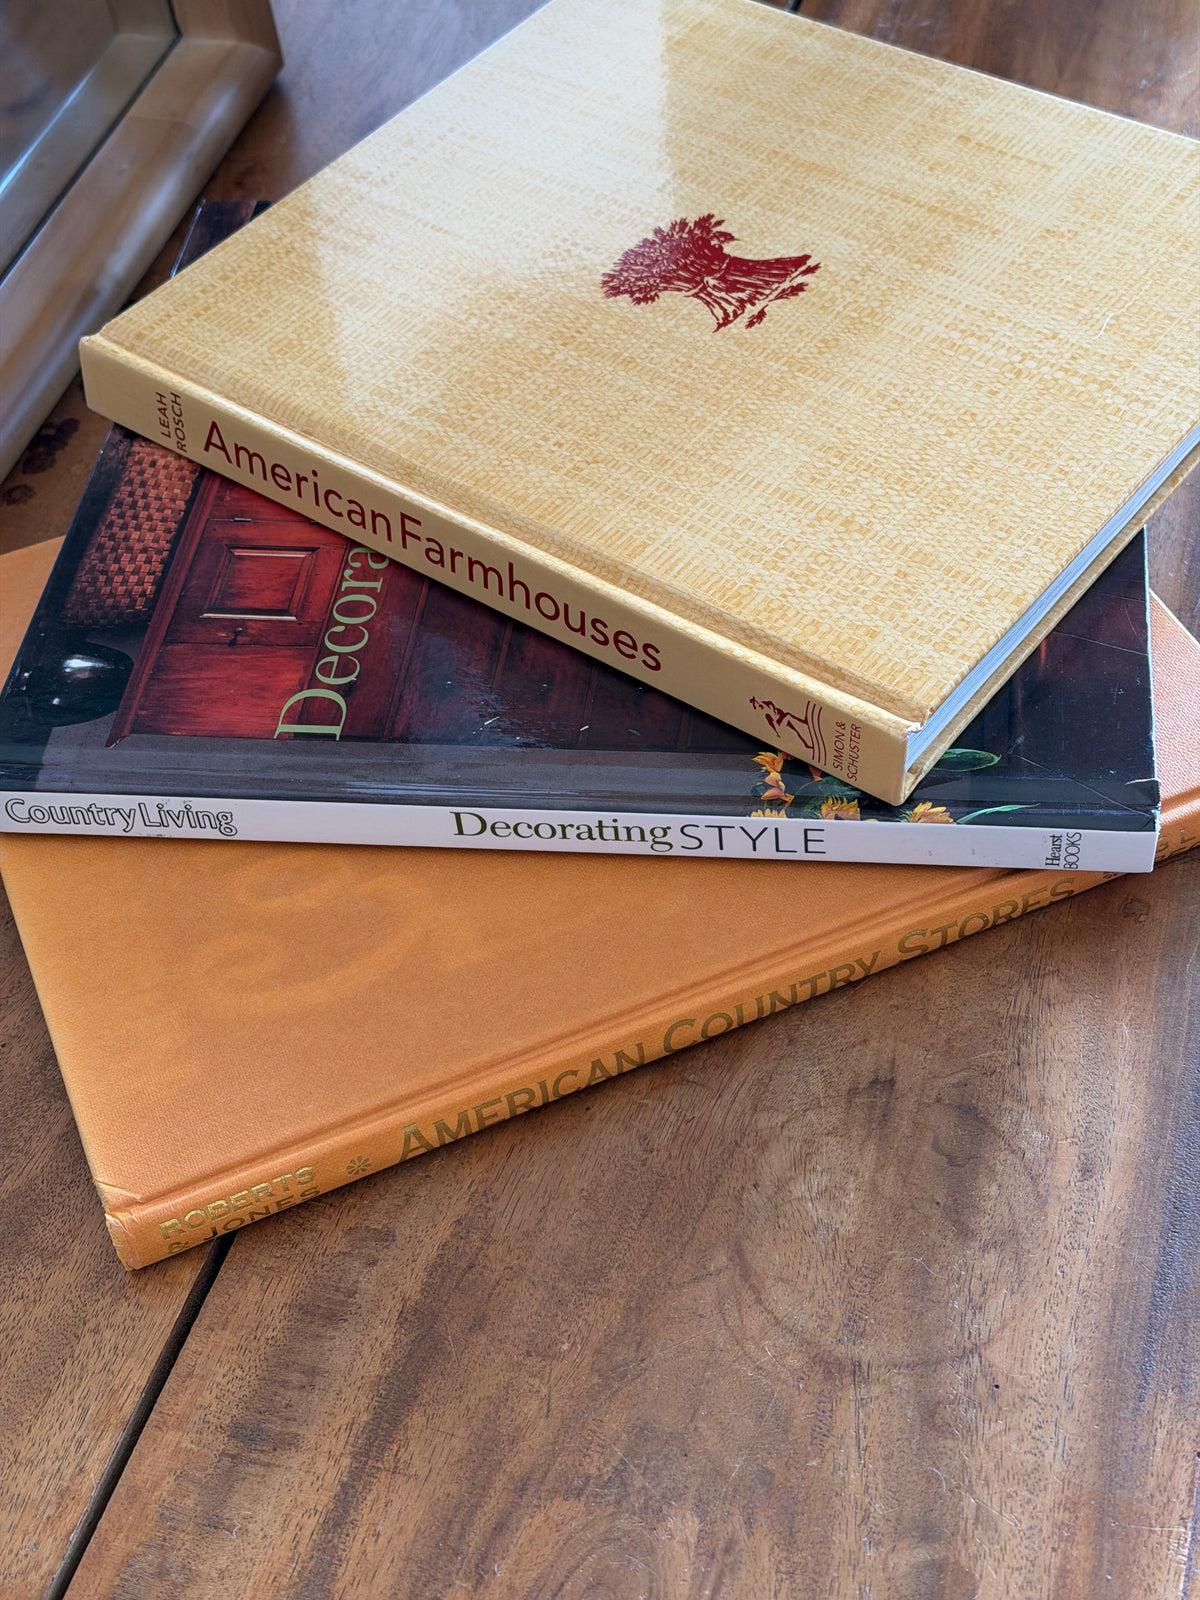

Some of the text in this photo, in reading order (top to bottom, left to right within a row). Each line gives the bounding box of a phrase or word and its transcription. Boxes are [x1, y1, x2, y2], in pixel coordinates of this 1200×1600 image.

[155, 392, 171, 439] LEAH
[171, 392, 188, 453] ROSCH
[832, 727, 848, 771] SIMON
[846, 723, 862, 782] SCHUSTER
[449, 811, 827, 854] Decorating STYLE
[1045, 834, 1063, 867] Hearst
[1063, 831, 1082, 870] BOOKS
[399, 877, 1075, 1163] AMERICAN COUNTRY STORES
[158, 1165, 316, 1241] ROBERTS
[167, 1186, 321, 1255] & JONES
